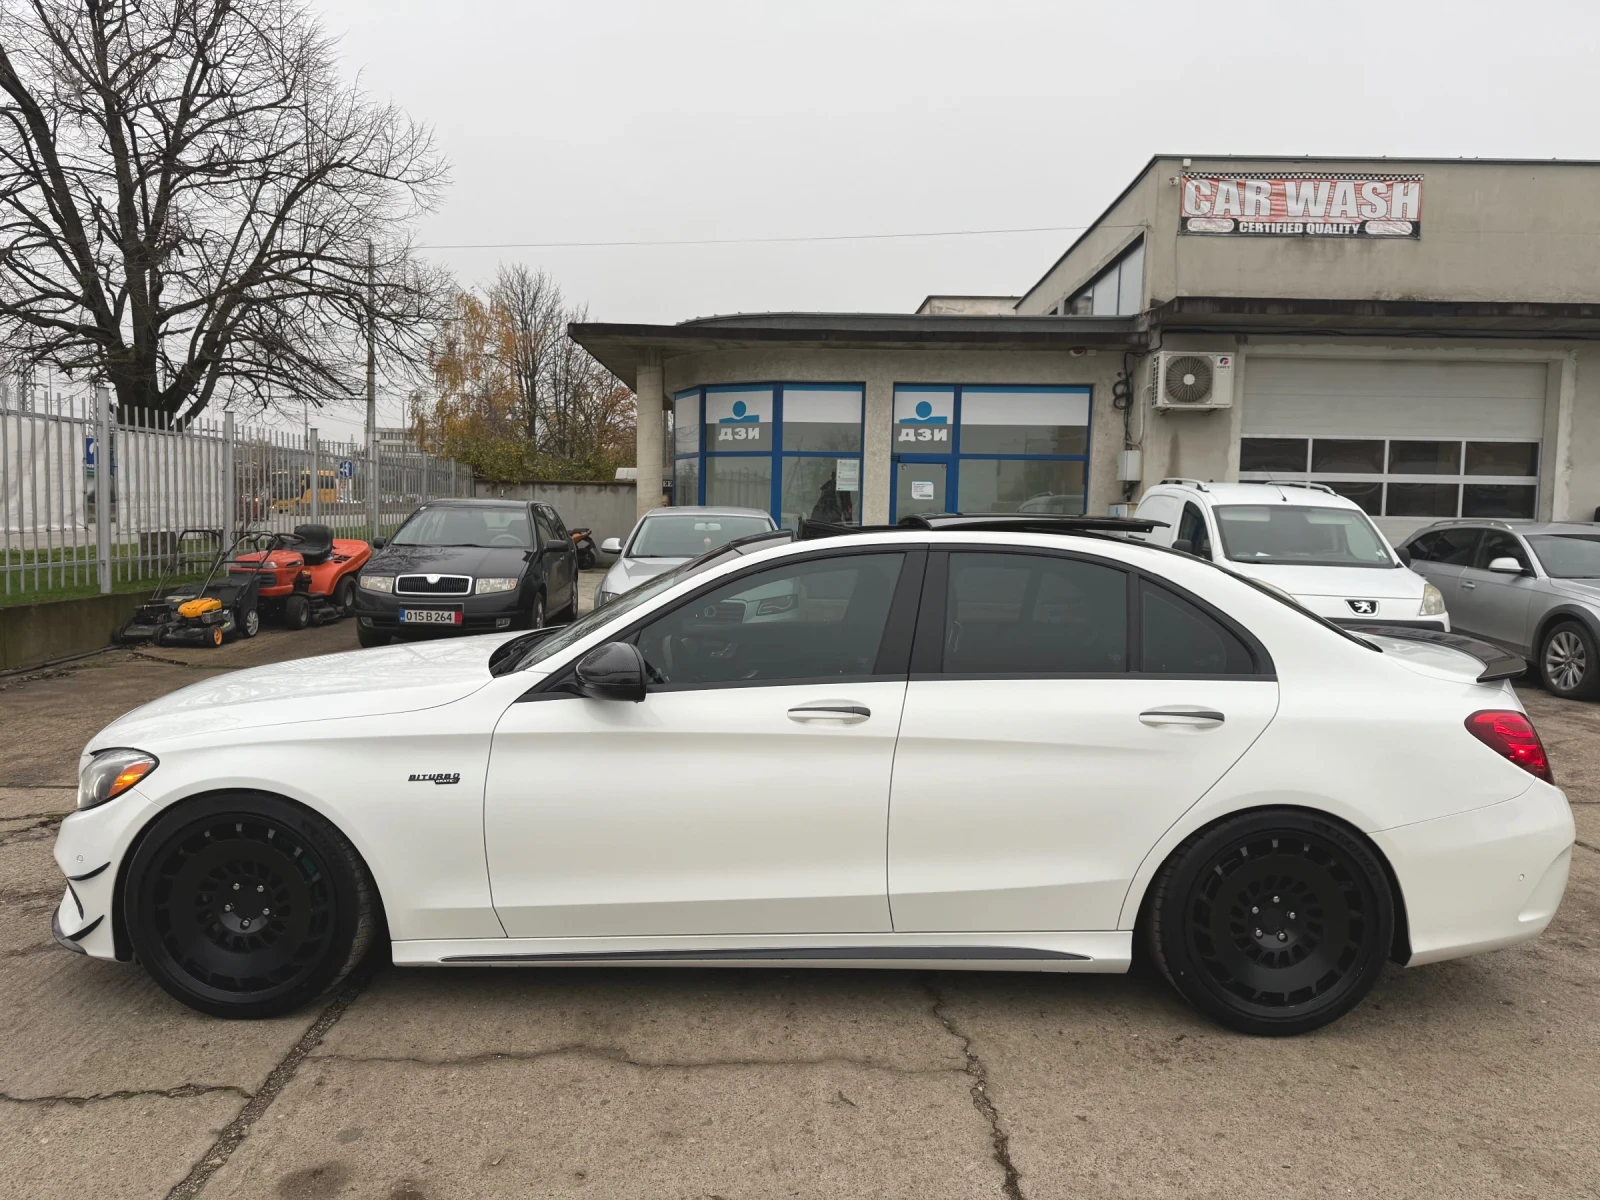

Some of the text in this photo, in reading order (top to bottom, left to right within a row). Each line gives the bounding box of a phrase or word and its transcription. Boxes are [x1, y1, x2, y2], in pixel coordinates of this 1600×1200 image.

[1183, 178, 1421, 220] CAR WASH
[1239, 221, 1304, 234] CERTIFIED
[1306, 222, 1361, 235] QUALITY
[718, 427, 760, 441] ДЗИ
[898, 428, 948, 442] ДЗИ
